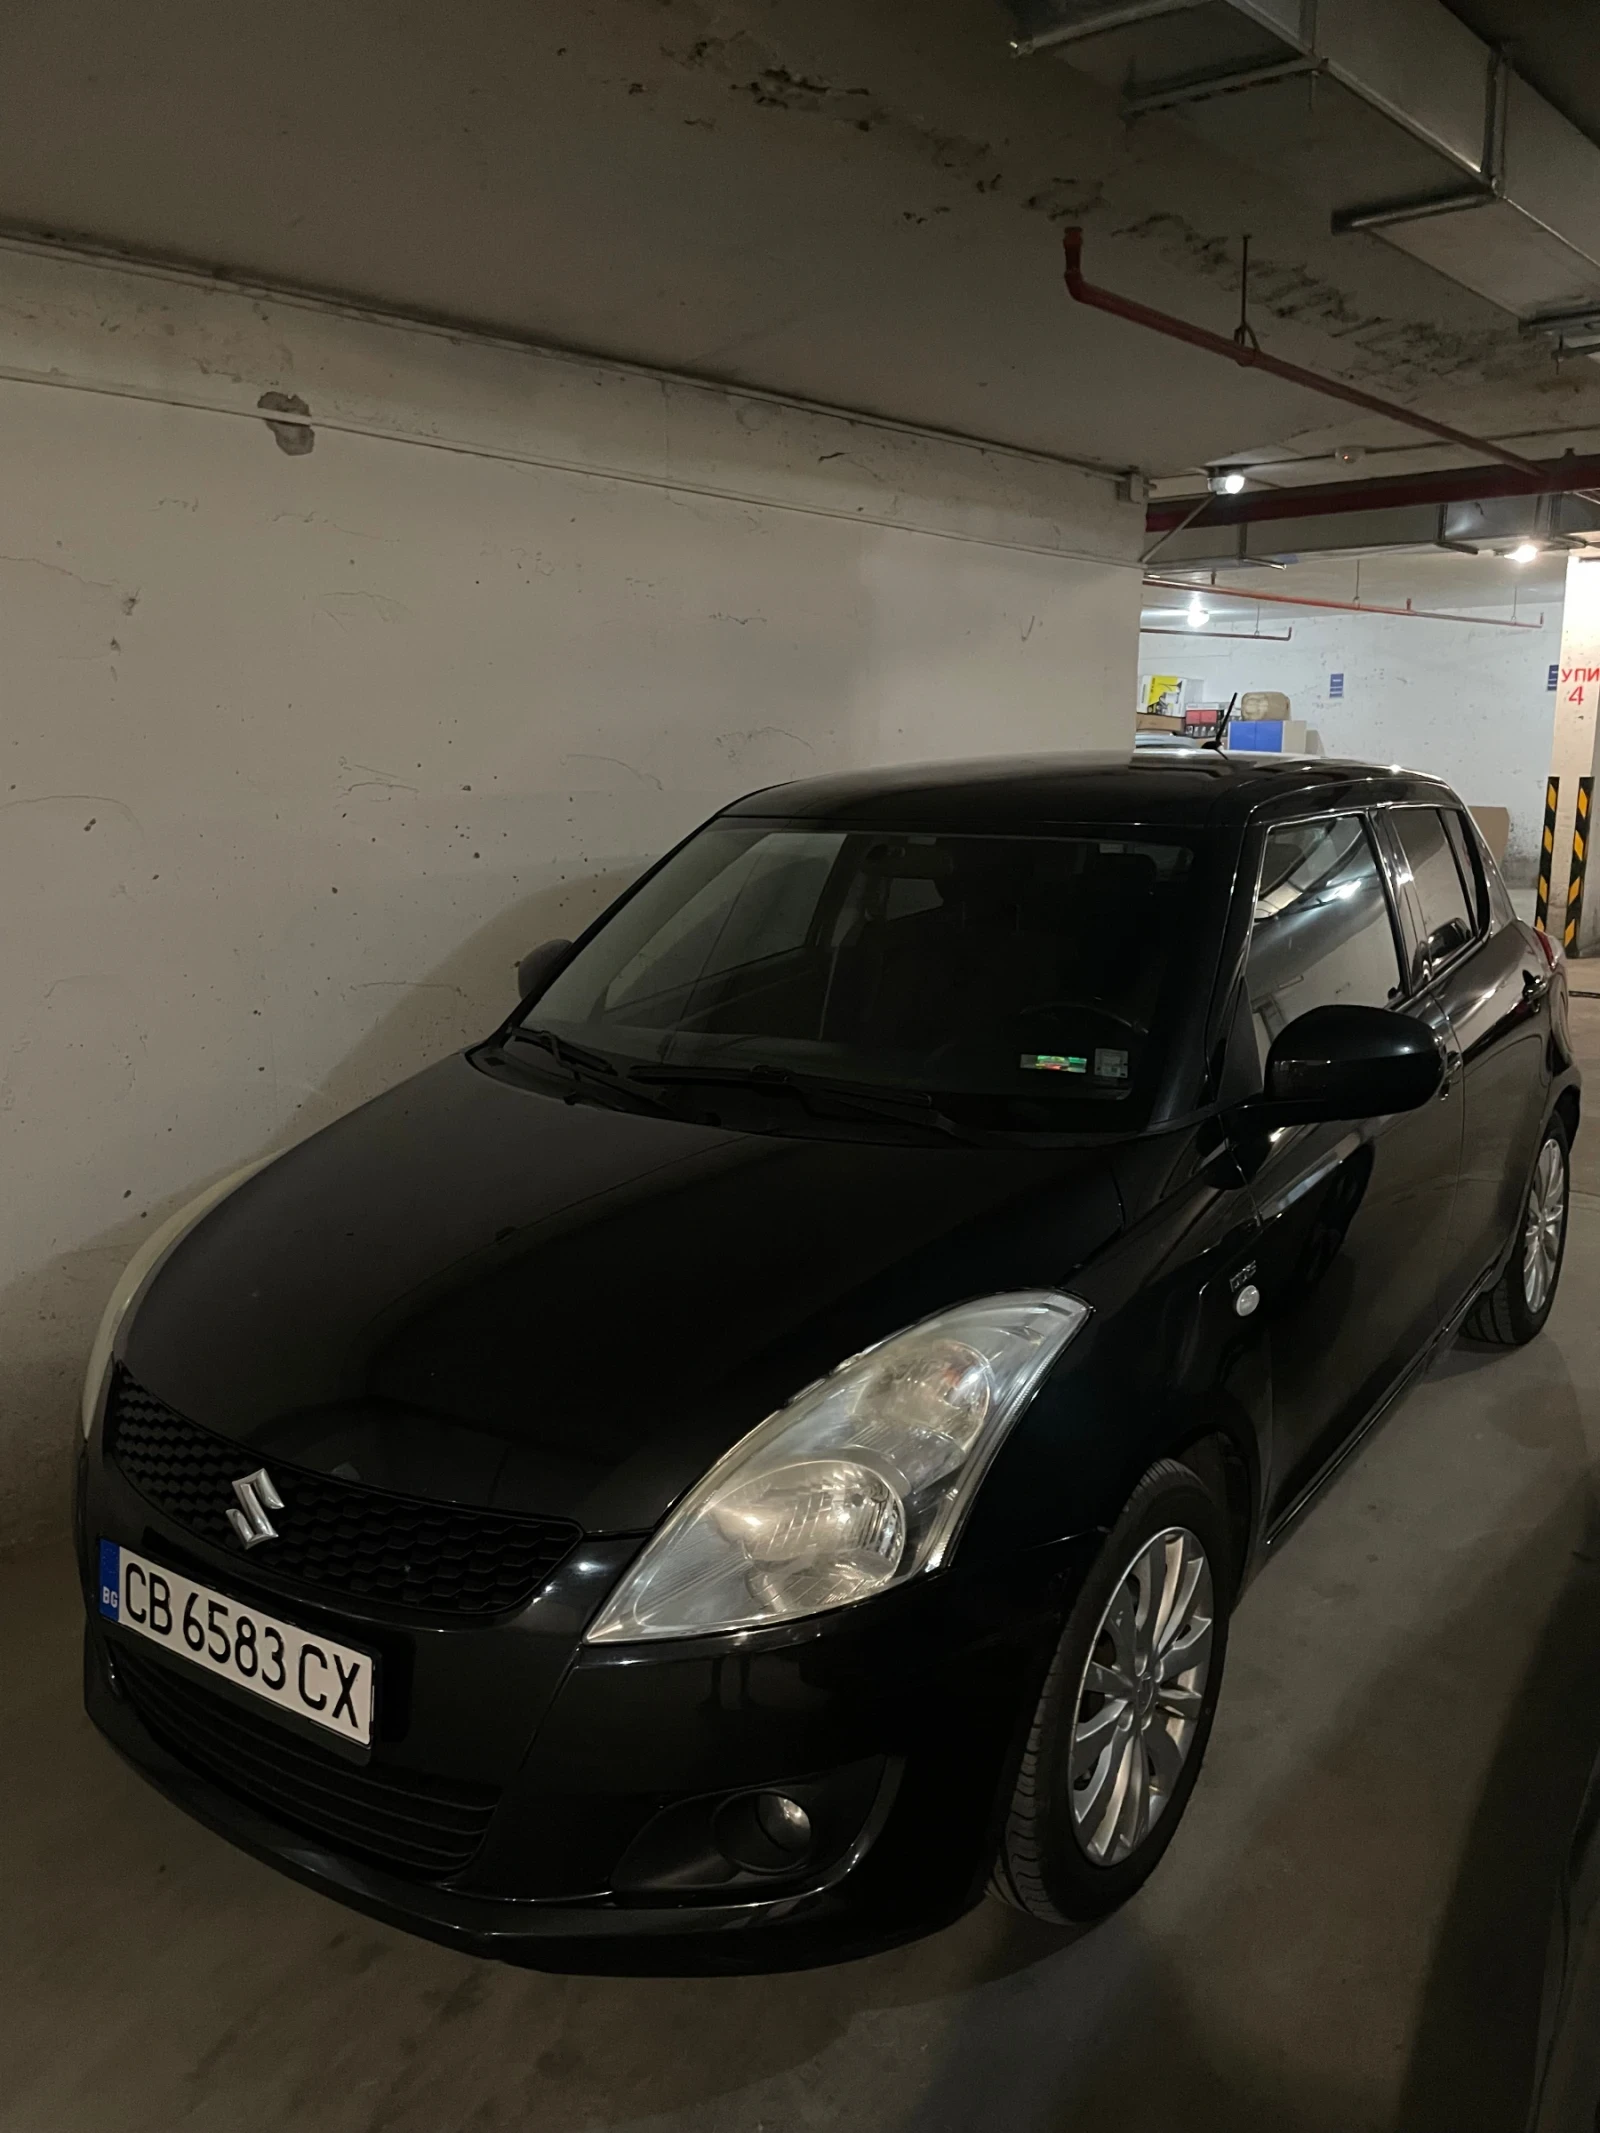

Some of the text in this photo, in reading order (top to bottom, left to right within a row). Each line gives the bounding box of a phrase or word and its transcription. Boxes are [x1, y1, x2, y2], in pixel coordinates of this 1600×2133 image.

[1561, 668, 1600, 682] УПИ
[1568, 686, 1584, 705] 4
[102, 1586, 119, 1609] BG
[125, 1562, 361, 1729] CB 6583 CX
